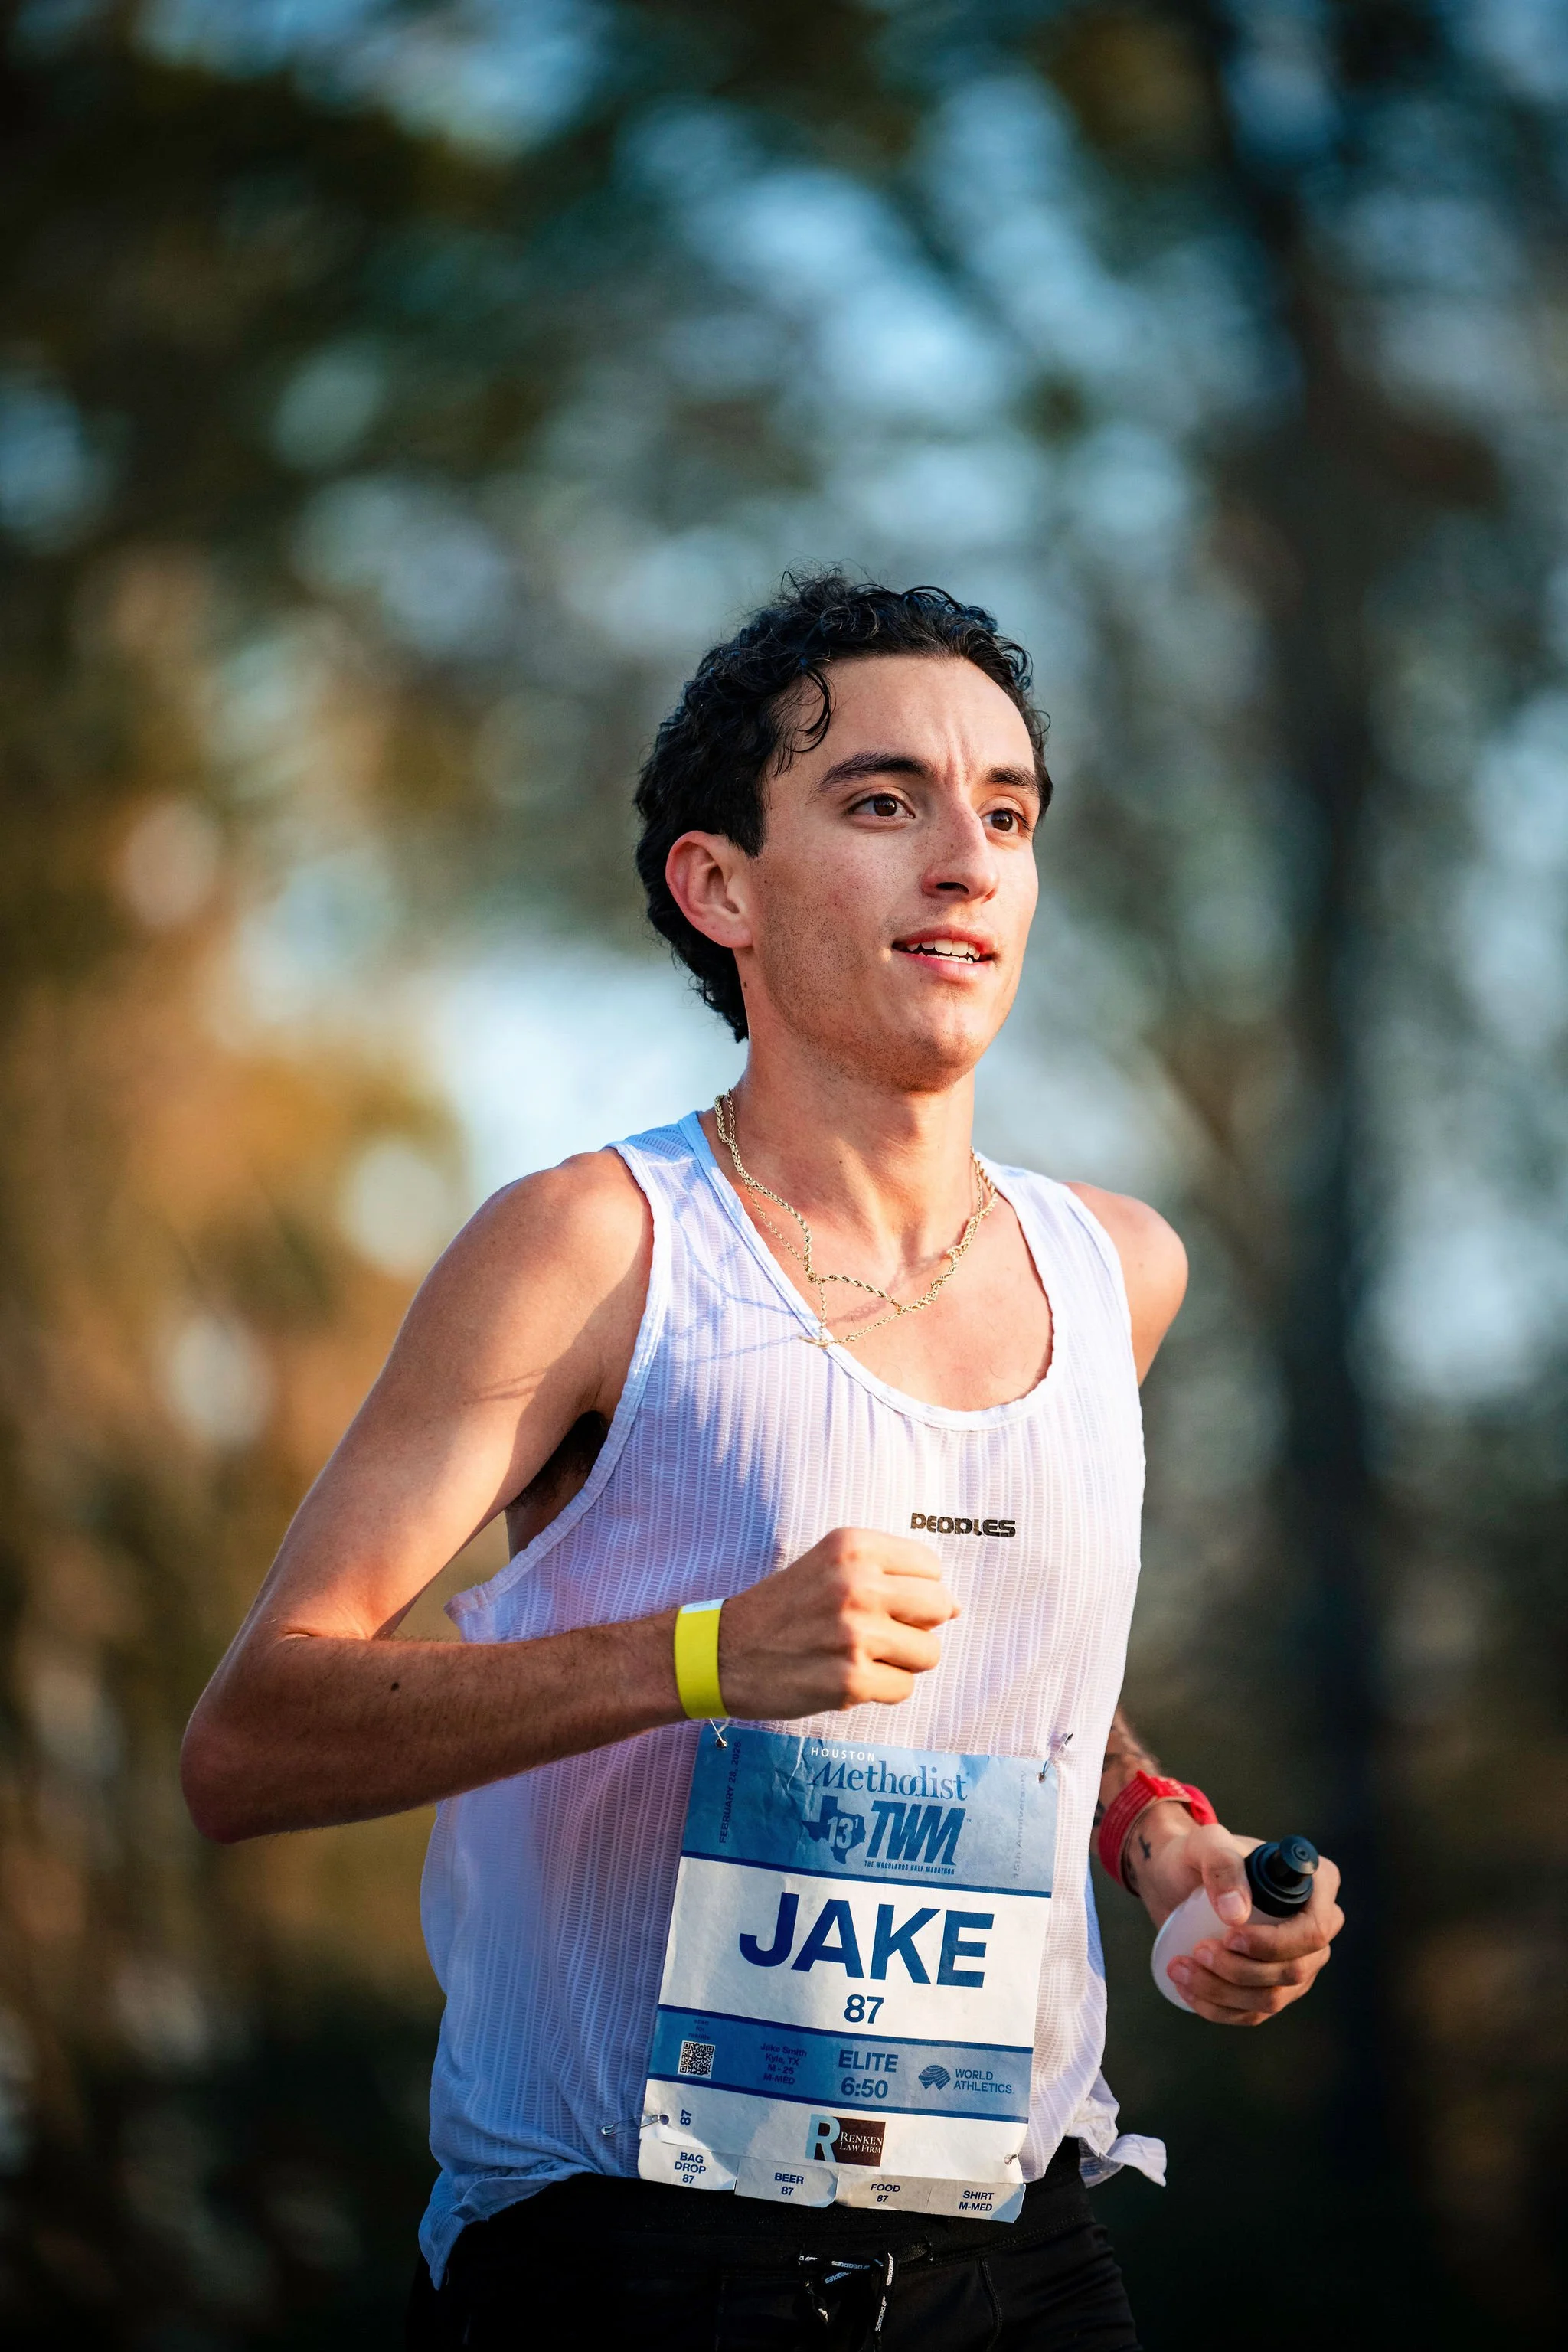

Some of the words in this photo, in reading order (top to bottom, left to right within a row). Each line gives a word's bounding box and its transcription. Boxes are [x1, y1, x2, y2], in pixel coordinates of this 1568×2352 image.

[910, 1513, 1016, 1537] PEOPLES
[811, 1747, 875, 1762] HOUSTON
[807, 1760, 968, 1802] Methodist
[720, 1785, 734, 1844] FEBRUARY
[731, 1741, 741, 1766] 2026
[866, 1800, 966, 1866] TWM
[876, 1861, 909, 1871] WOODLANDS
[925, 1866, 955, 1875] MARATHON
[739, 1893, 995, 1988] JAKE
[844, 1994, 884, 2024] 87
[760, 2043, 781, 2053] Jake
[782, 2045, 807, 2057] Smith
[766, 2053, 785, 2065] Kyle,
[789, 2057, 799, 2066] TX
[838, 2049, 899, 2073] ELITE
[782, 2066, 794, 2075] 25
[956, 2069, 994, 2080] WORLD
[763, 2073, 795, 2085] M-MED
[841, 2076, 888, 2099] 6:50
[954, 2079, 1012, 2094] ATHLETICS
[680, 2109, 692, 2126] 87
[841, 2132, 884, 2145] RENKEN
[839, 2144, 860, 2152] LAW
[861, 2144, 881, 2154] FIRM
[680, 2151, 704, 2164] BAG
[674, 2161, 707, 2174] DROP
[682, 2174, 695, 2184] 87
[774, 2172, 804, 2184] BEER
[782, 2186, 794, 2196] 87
[871, 2184, 900, 2193] FOOD
[962, 2190, 995, 2200] SHIRT
[876, 2194, 888, 2203] 87
[959, 2201, 993, 2212] M-MED
